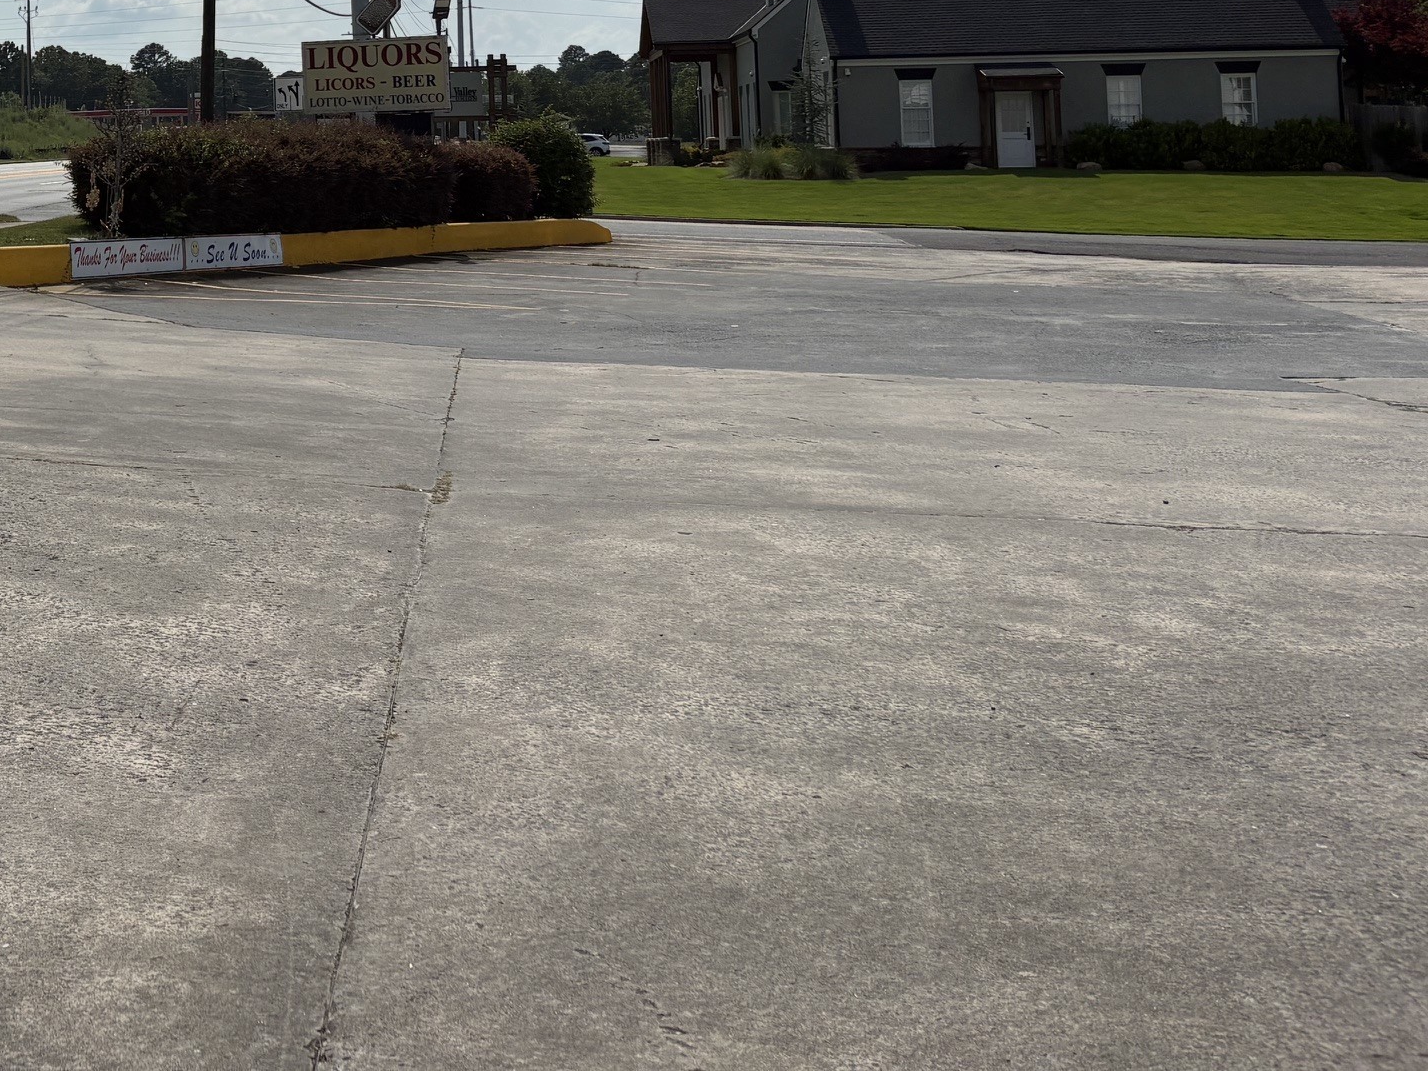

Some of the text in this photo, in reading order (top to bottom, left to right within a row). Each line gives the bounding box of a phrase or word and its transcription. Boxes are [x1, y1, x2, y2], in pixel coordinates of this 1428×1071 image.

[307, 41, 442, 72] LIQUORS
[315, 76, 376, 91] LICORS
[392, 74, 437, 88] BEER
[74, 246, 102, 268] Thanks
[104, 246, 118, 268] For
[119, 244, 137, 271] Your
[228, 241, 239, 261] U
